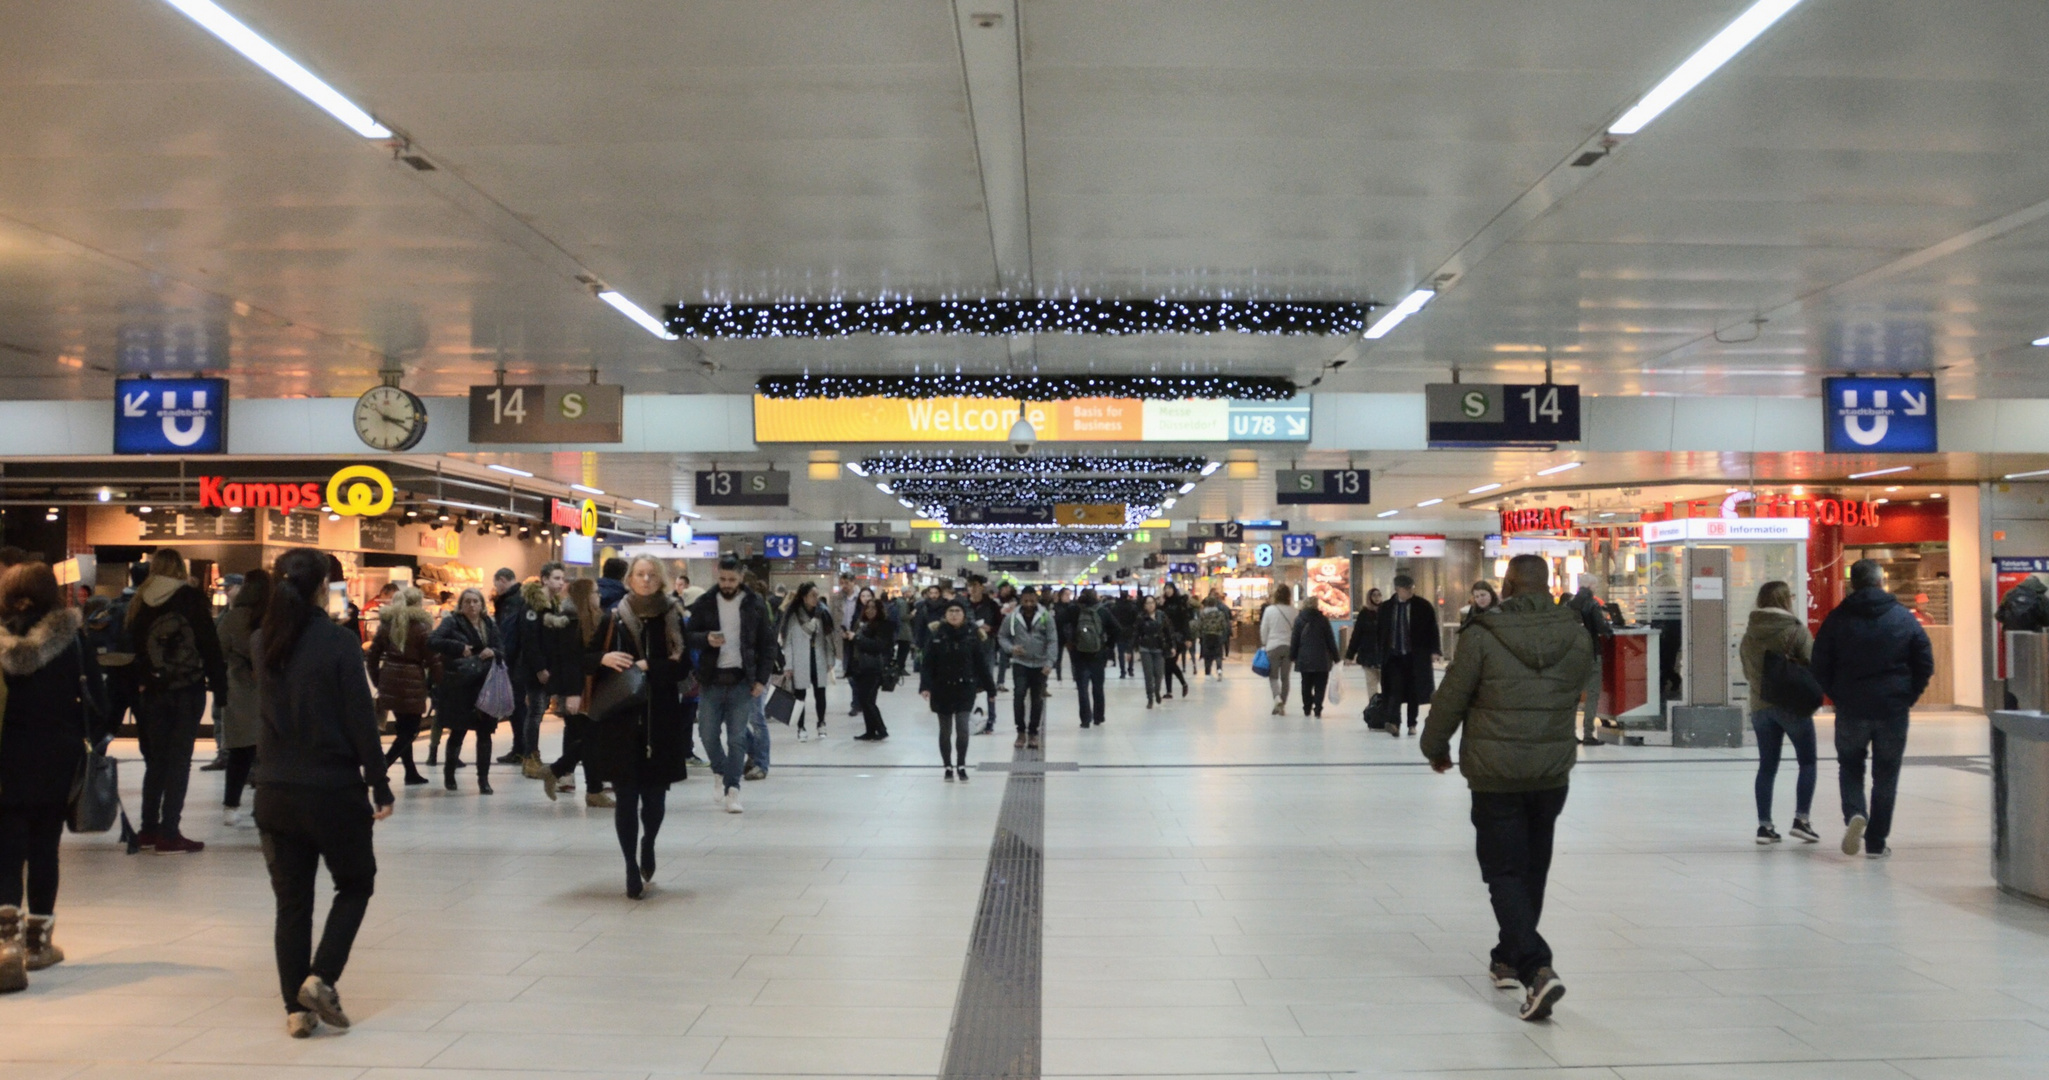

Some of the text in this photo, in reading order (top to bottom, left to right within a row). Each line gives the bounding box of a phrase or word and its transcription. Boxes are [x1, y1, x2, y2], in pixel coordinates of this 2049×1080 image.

[157, 409, 212, 417] stadtbahn
[486, 388, 583, 424] 14 S
[1073, 405, 1123, 417] Basis for
[1159, 407, 1192, 416] Messe
[1464, 388, 1562, 423] S 14
[1839, 408, 1894, 416] stadtbahn
[162, 391, 206, 446] U
[906, 401, 1045, 431] Welcome
[1159, 419, 1217, 429] Düsseldorf
[1843, 390, 1888, 445] U
[1073, 420, 1122, 431] Business
[1233, 416, 1276, 435] U78
[706, 472, 765, 495] 13 S
[1300, 471, 1360, 494] S 13
[199, 476, 320, 515] Kamps
[841, 524, 857, 538] 12
[1221, 523, 1238, 538] 12
[1730, 525, 1788, 534] Information
